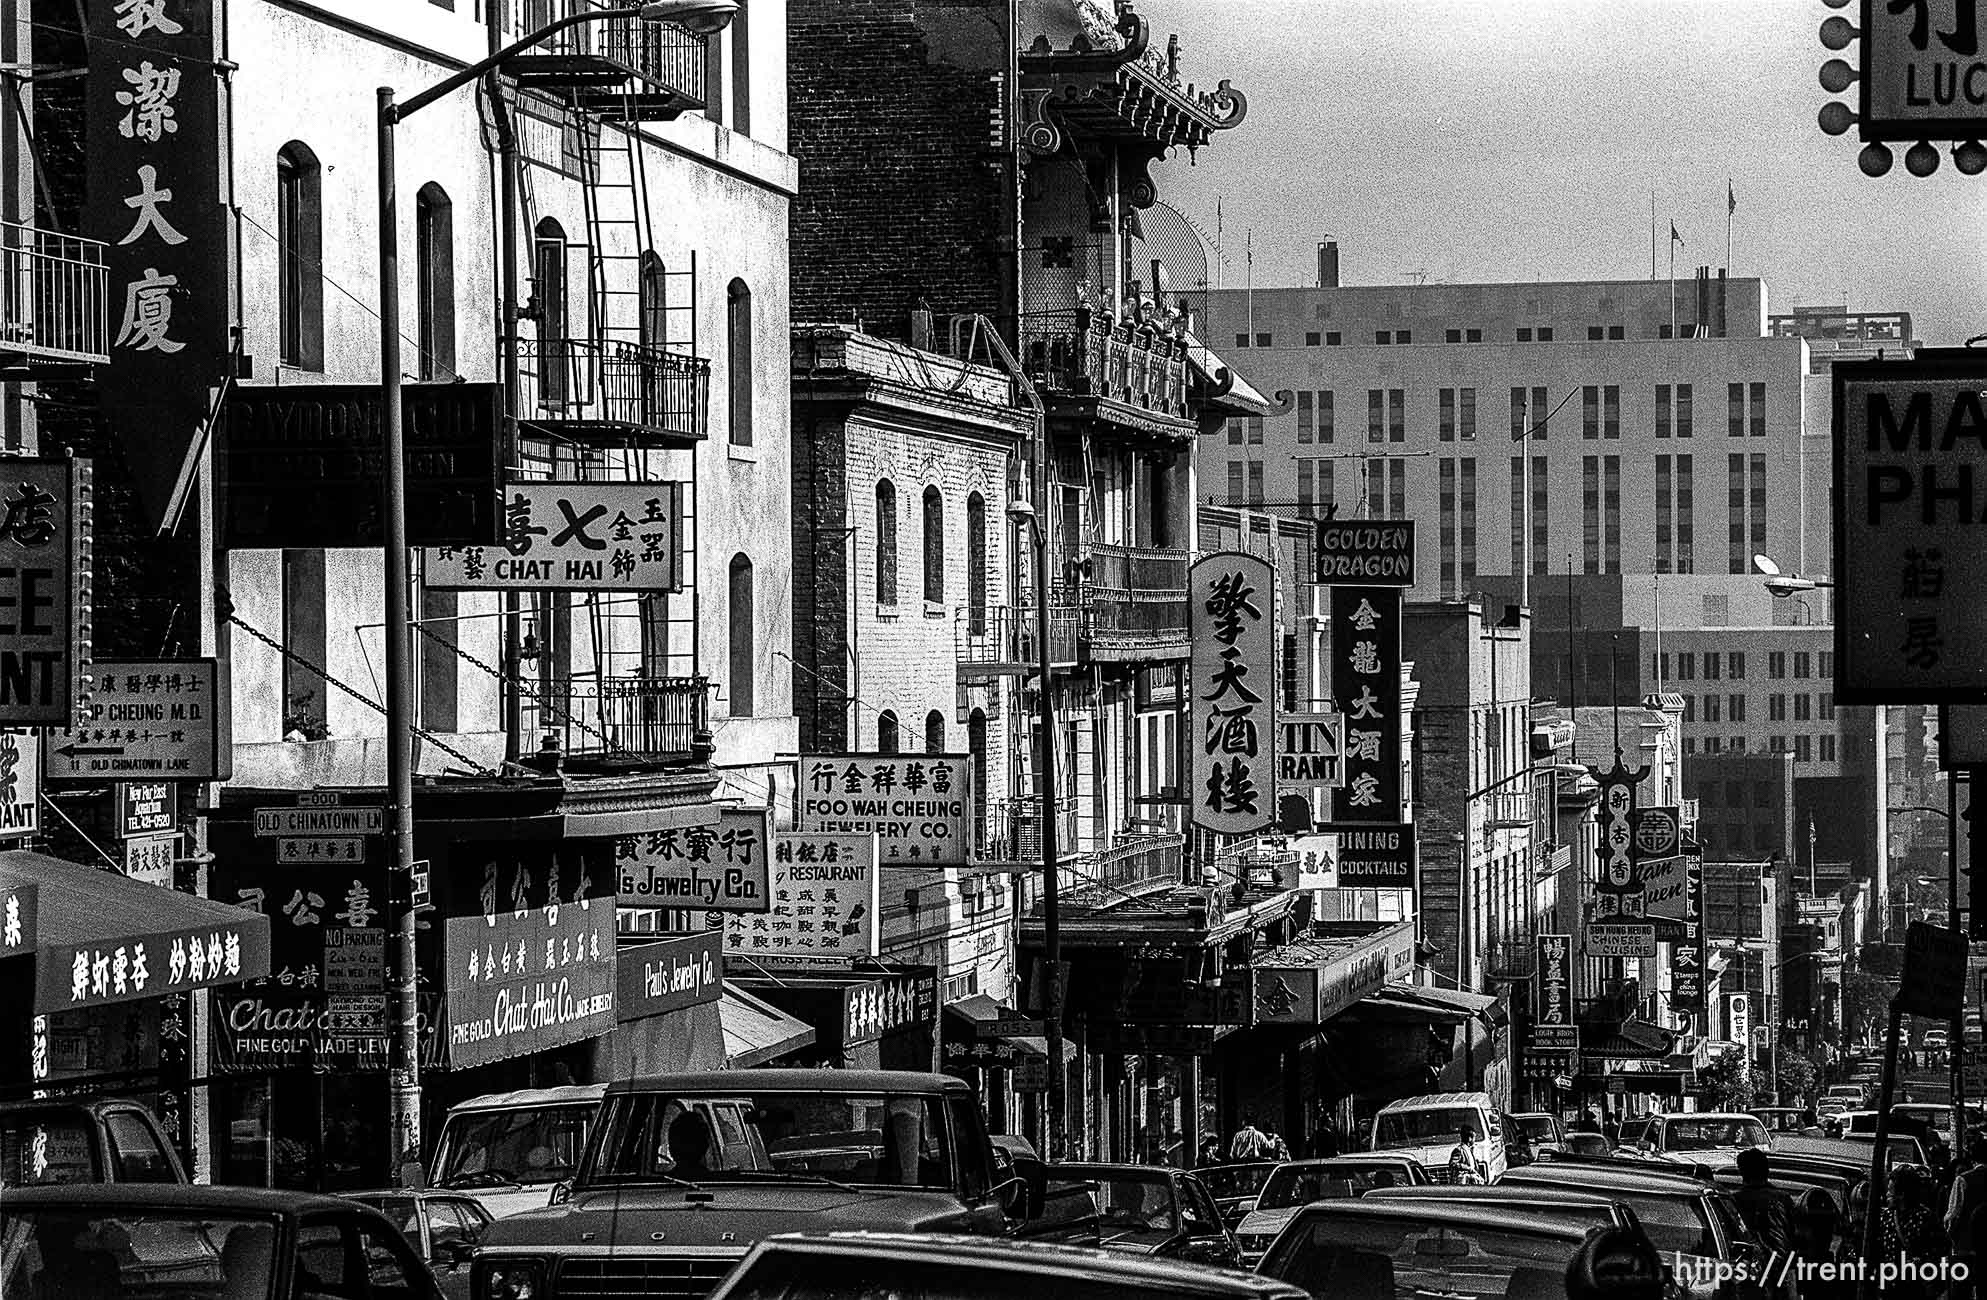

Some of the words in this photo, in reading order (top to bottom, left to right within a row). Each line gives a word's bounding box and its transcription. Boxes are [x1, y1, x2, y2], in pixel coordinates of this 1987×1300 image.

[1867, 464, 1987, 526] PH
[1324, 528, 1408, 550] GOLDEN
[495, 560, 554, 580] CHAT
[565, 560, 603, 580] HAI
[1321, 554, 1410, 577] DRAGON
[109, 703, 163, 721] CHEUNG
[1346, 597, 1385, 809] 金龍大酒家
[70, 759, 80, 771] 11
[91, 759, 109, 771] OLD
[112, 759, 162, 771] CHINATOWN
[167, 759, 191, 771] LANE
[1282, 755, 1340, 780] RANT
[806, 800, 848, 816] FOO
[852, 800, 888, 817] WAH
[892, 800, 962, 818] CHEUNG
[257, 813, 280, 831] OLD
[289, 811, 360, 830] CHINATOWN
[367, 811, 381, 829] LN
[919, 822, 953, 839] CO.
[789, 866, 866, 881] RESTAURANT
[1340, 861, 1407, 875] COCKTAILS
[637, 865, 722, 905] Jewelry
[725, 868, 760, 899] Co.
[1647, 882, 1682, 904] uen
[326, 929, 341, 946] NO
[345, 931, 382, 946] PARKING
[1592, 935, 1641, 945] CHINESE
[1603, 945, 1650, 955] CUISINE
[645, 960, 668, 999] Paul's
[670, 957, 700, 998] Jewelry
[703, 950, 716, 985] Co.
[230, 999, 316, 1032] Chat
[494, 985, 528, 1038] Chat
[531, 982, 557, 1030] Hai
[558, 977, 574, 1024] Co.
[452, 1024, 469, 1046] FINE
[469, 1018, 491, 1042] GOLD
[989, 1021, 1033, 1034] ROSS
[236, 1038, 270, 1055] FINE
[314, 1038, 356, 1055] JADE
[582, 1230, 737, 1241] FOR
